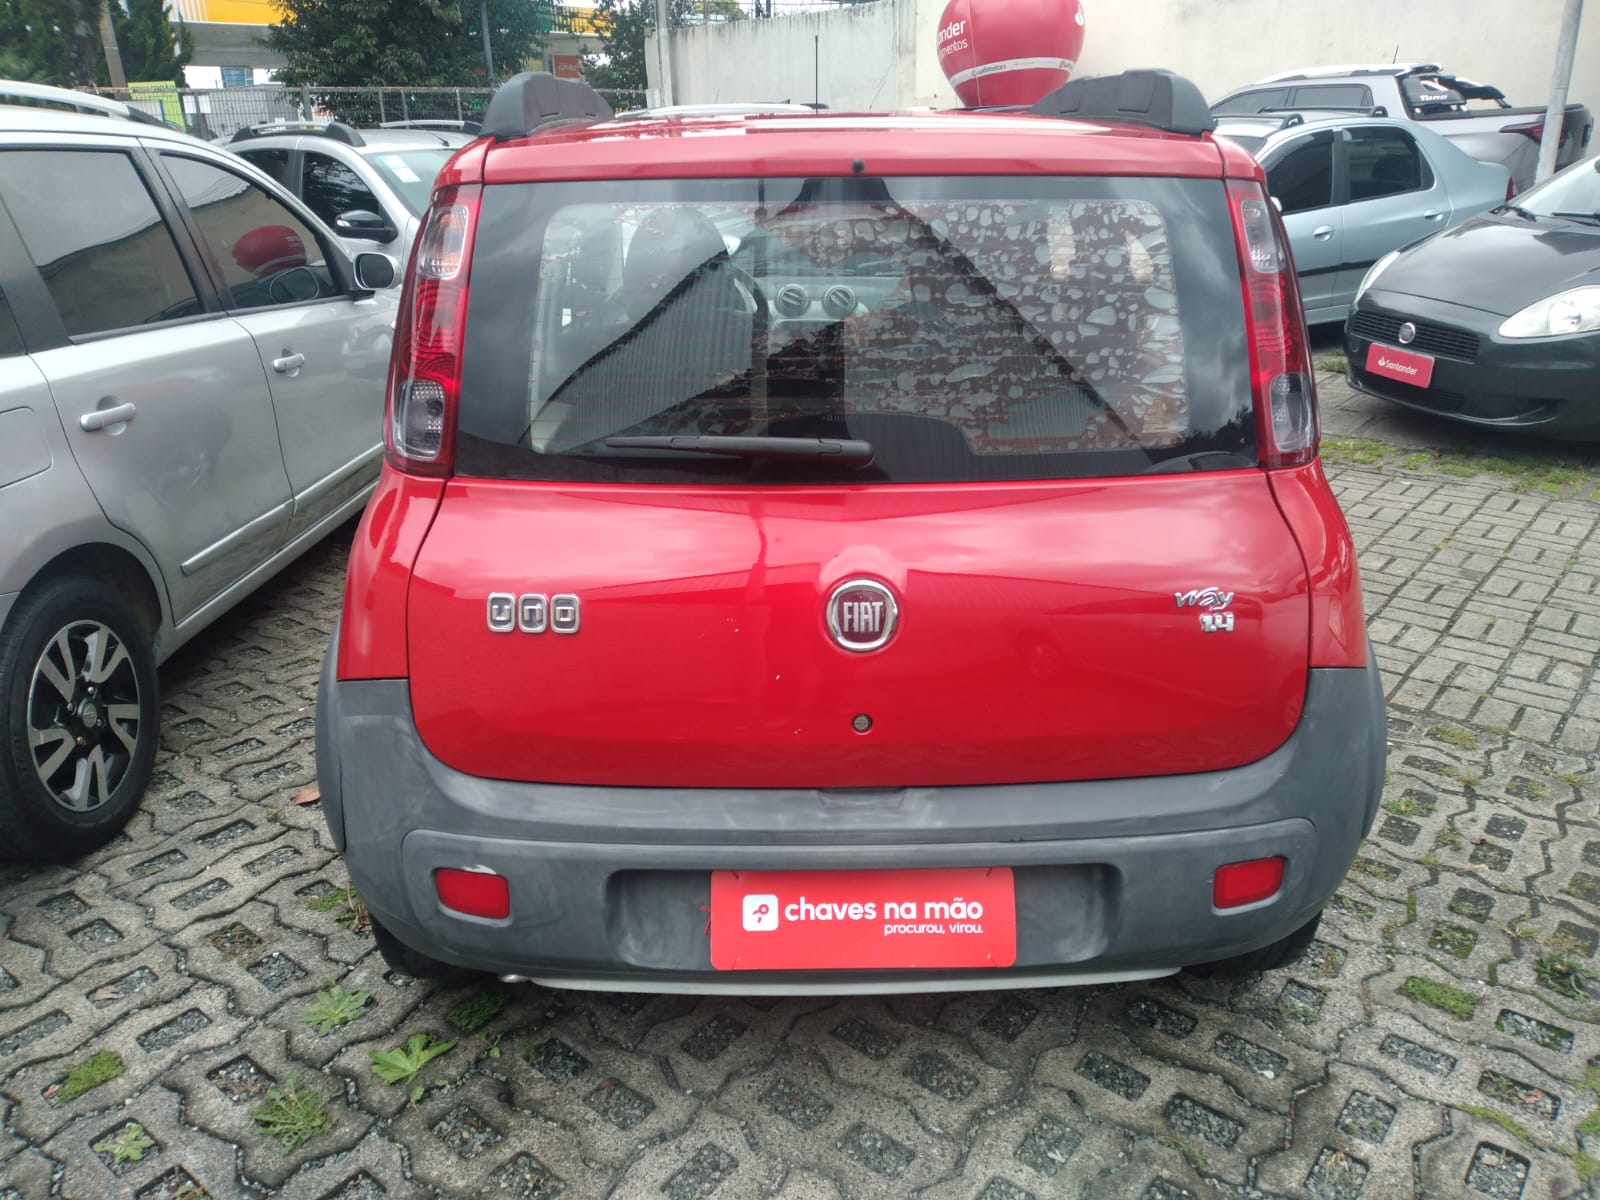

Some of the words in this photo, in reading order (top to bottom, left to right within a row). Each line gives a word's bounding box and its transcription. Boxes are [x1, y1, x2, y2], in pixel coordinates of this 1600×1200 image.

[1385, 359, 1418, 376] Santander
[843, 601, 884, 633] FIAT
[1199, 611, 1235, 632] 1.4
[784, 896, 877, 921] chaves
[884, 902, 917, 920] na
[924, 896, 983, 920] mão
[884, 921, 946, 936] procurou,
[949, 921, 983, 934] virou.
